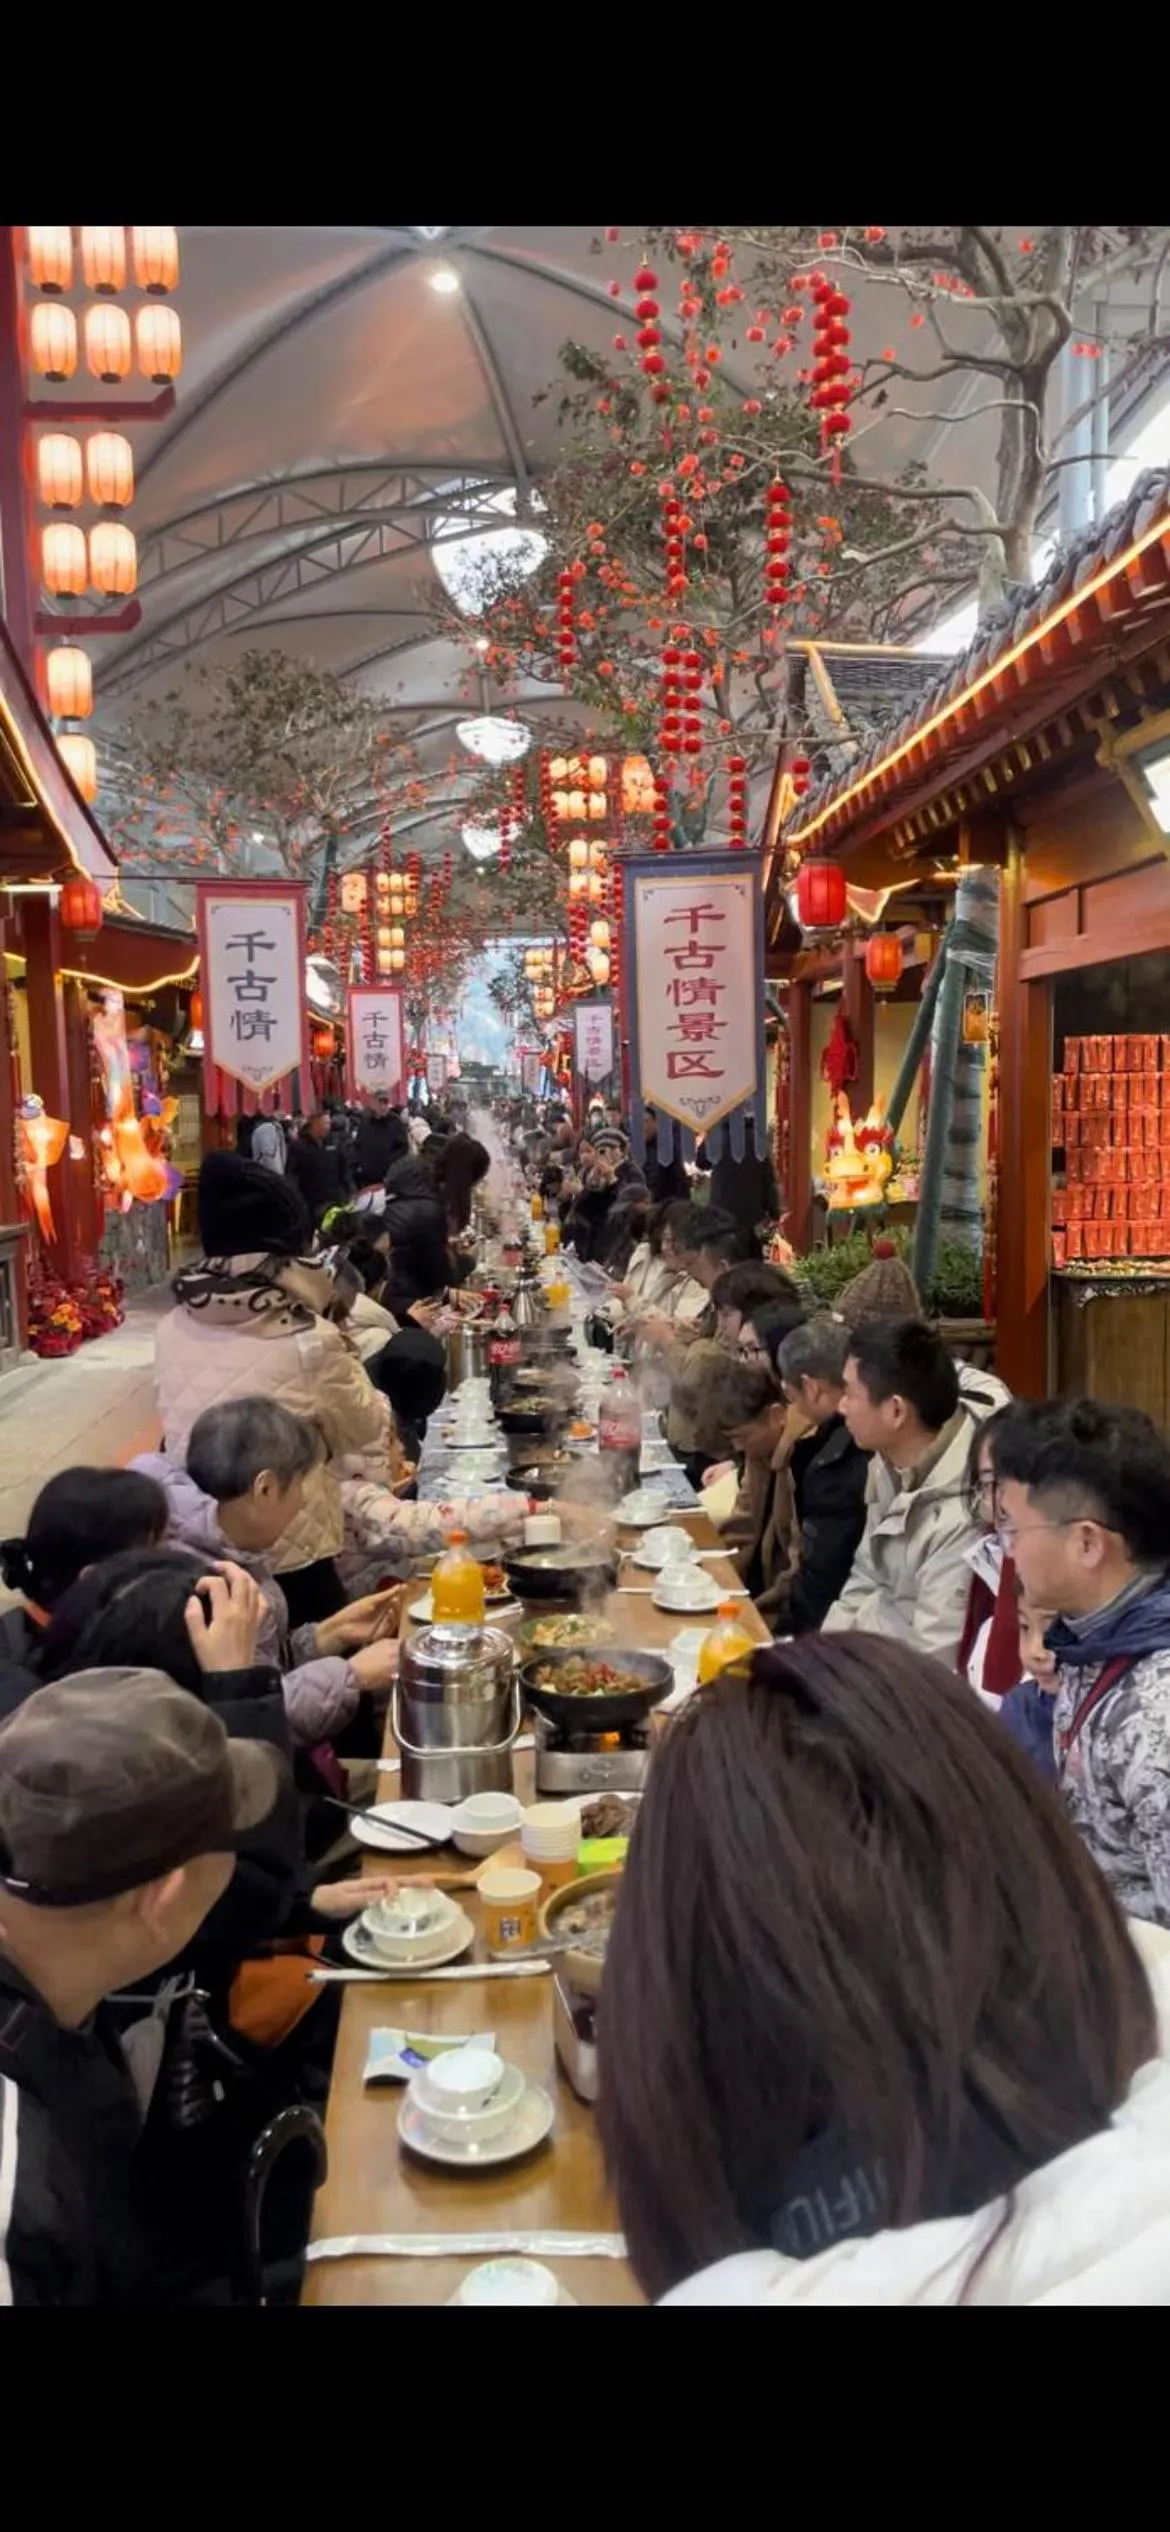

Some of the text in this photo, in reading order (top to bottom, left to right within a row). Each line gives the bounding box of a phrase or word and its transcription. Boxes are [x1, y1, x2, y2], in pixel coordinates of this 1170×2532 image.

[225, 931, 278, 1042] 千古情
[362, 1010, 390, 1070] 千古情
[663, 903, 728, 1080] 千古情景区
